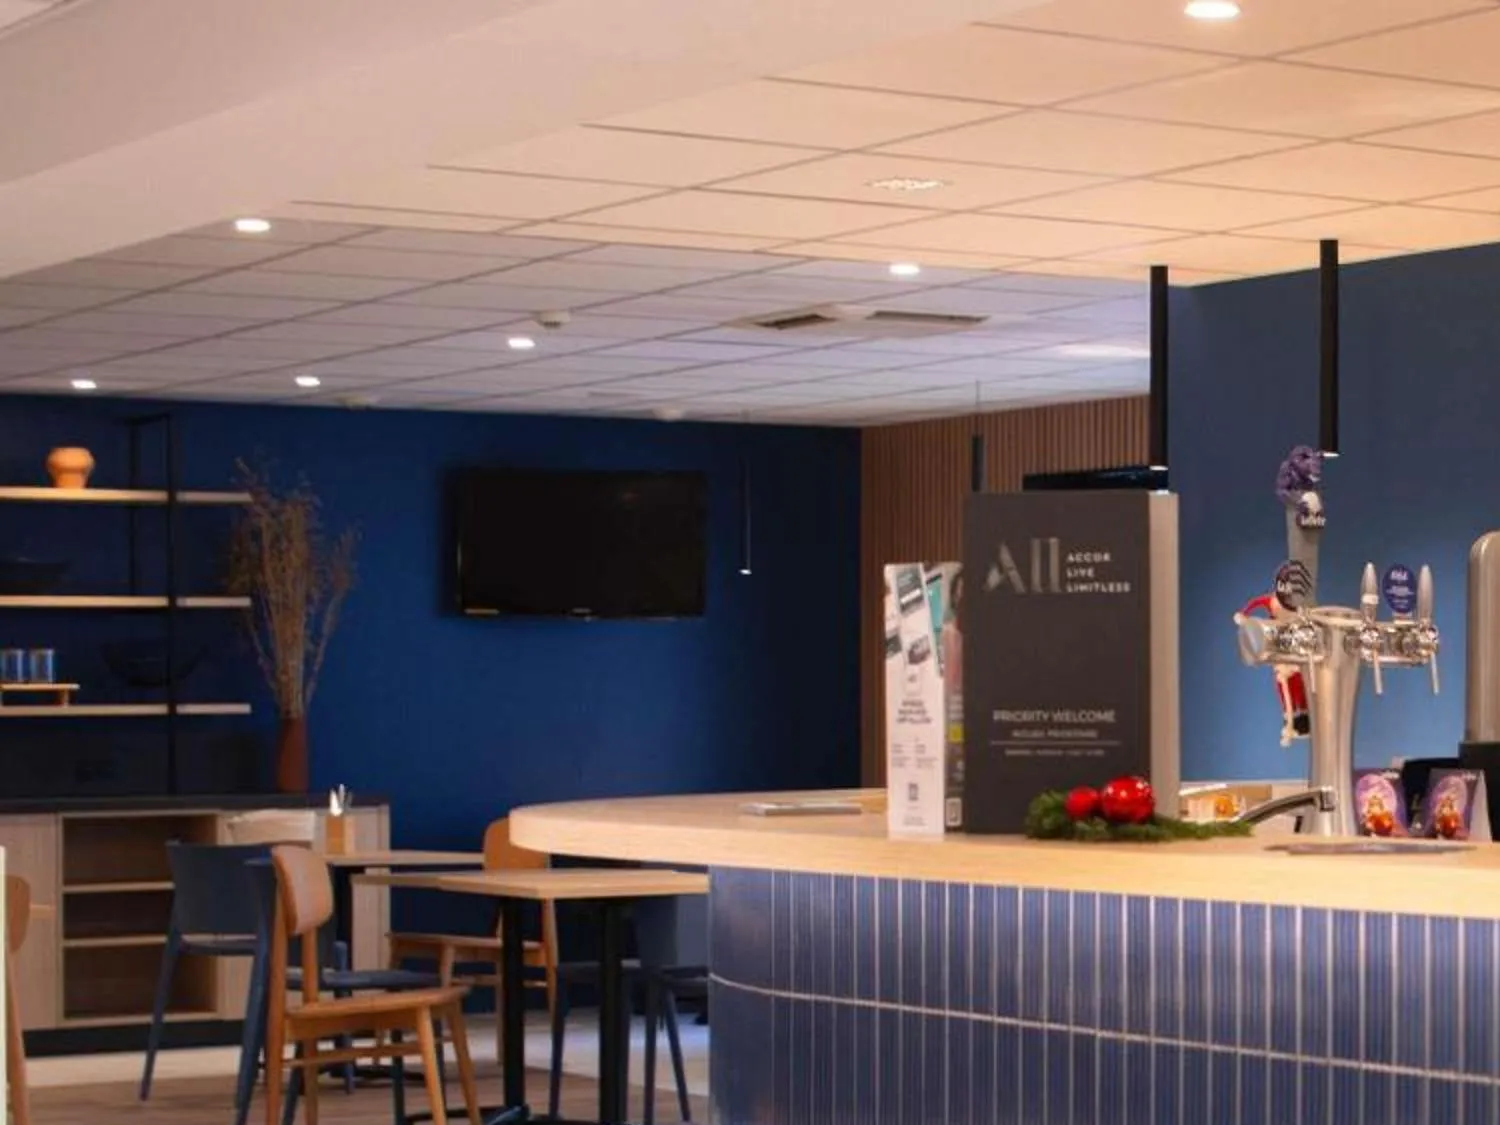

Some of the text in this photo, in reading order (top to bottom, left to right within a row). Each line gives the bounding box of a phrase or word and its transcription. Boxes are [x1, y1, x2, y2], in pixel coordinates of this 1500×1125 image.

[1066, 552, 1111, 563] ACCOR
[1066, 567, 1095, 578] LIVE
[1066, 582, 1131, 593] LIMITLESS
[1052, 709, 1116, 723] WELCOME
